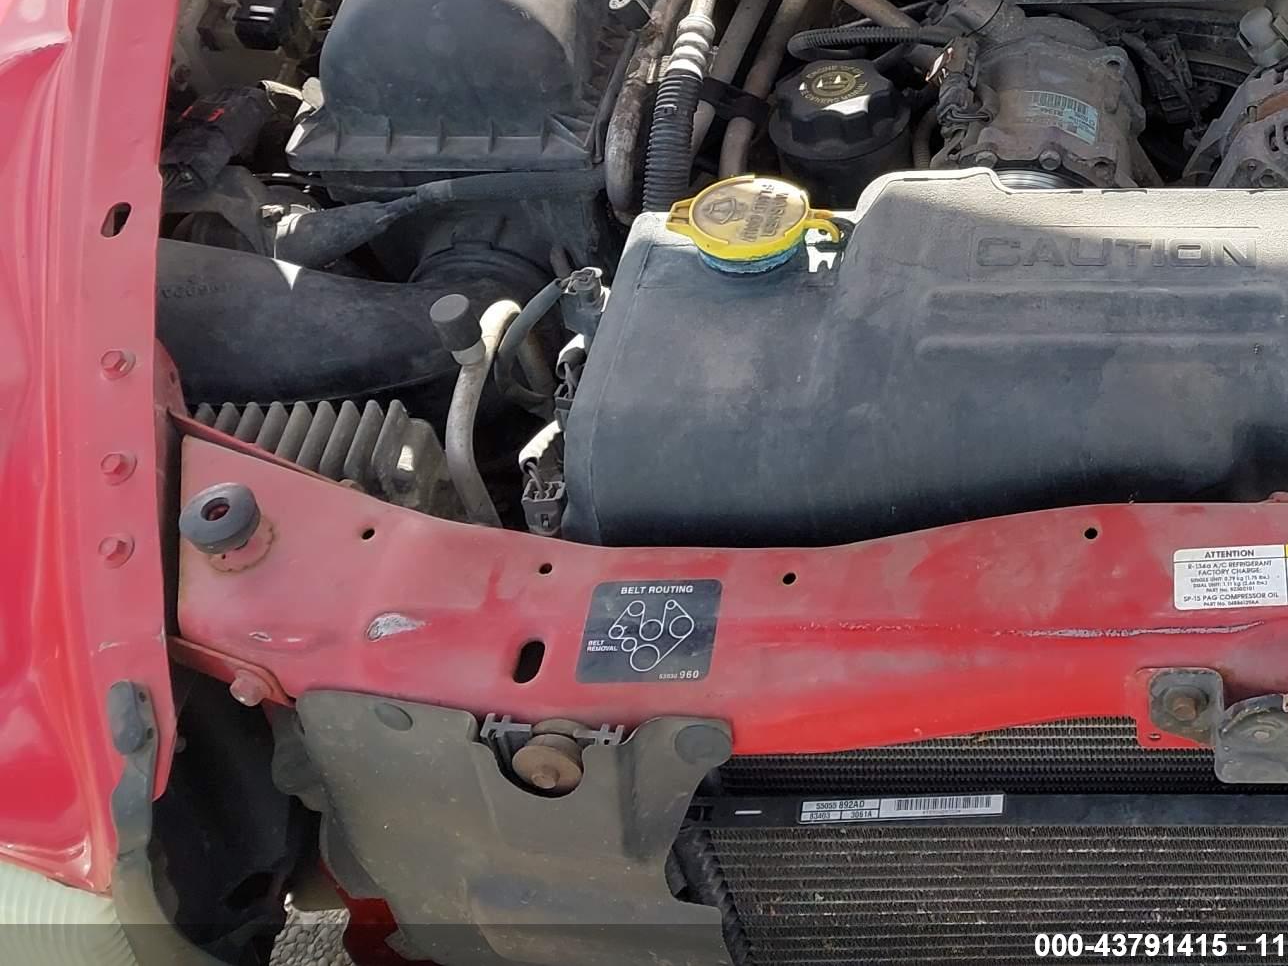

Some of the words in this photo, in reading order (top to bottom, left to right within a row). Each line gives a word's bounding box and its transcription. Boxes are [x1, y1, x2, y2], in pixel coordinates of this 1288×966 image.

[975, 237, 1257, 268] CAUTION
[1204, 549, 1255, 558] ATTENTION
[1228, 560, 1272, 568] REFRIGERANT
[1198, 568, 1230, 576] FACTORY
[620, 586, 646, 595] BELT
[648, 585, 694, 594] ROUTING
[679, 670, 700, 679] 960
